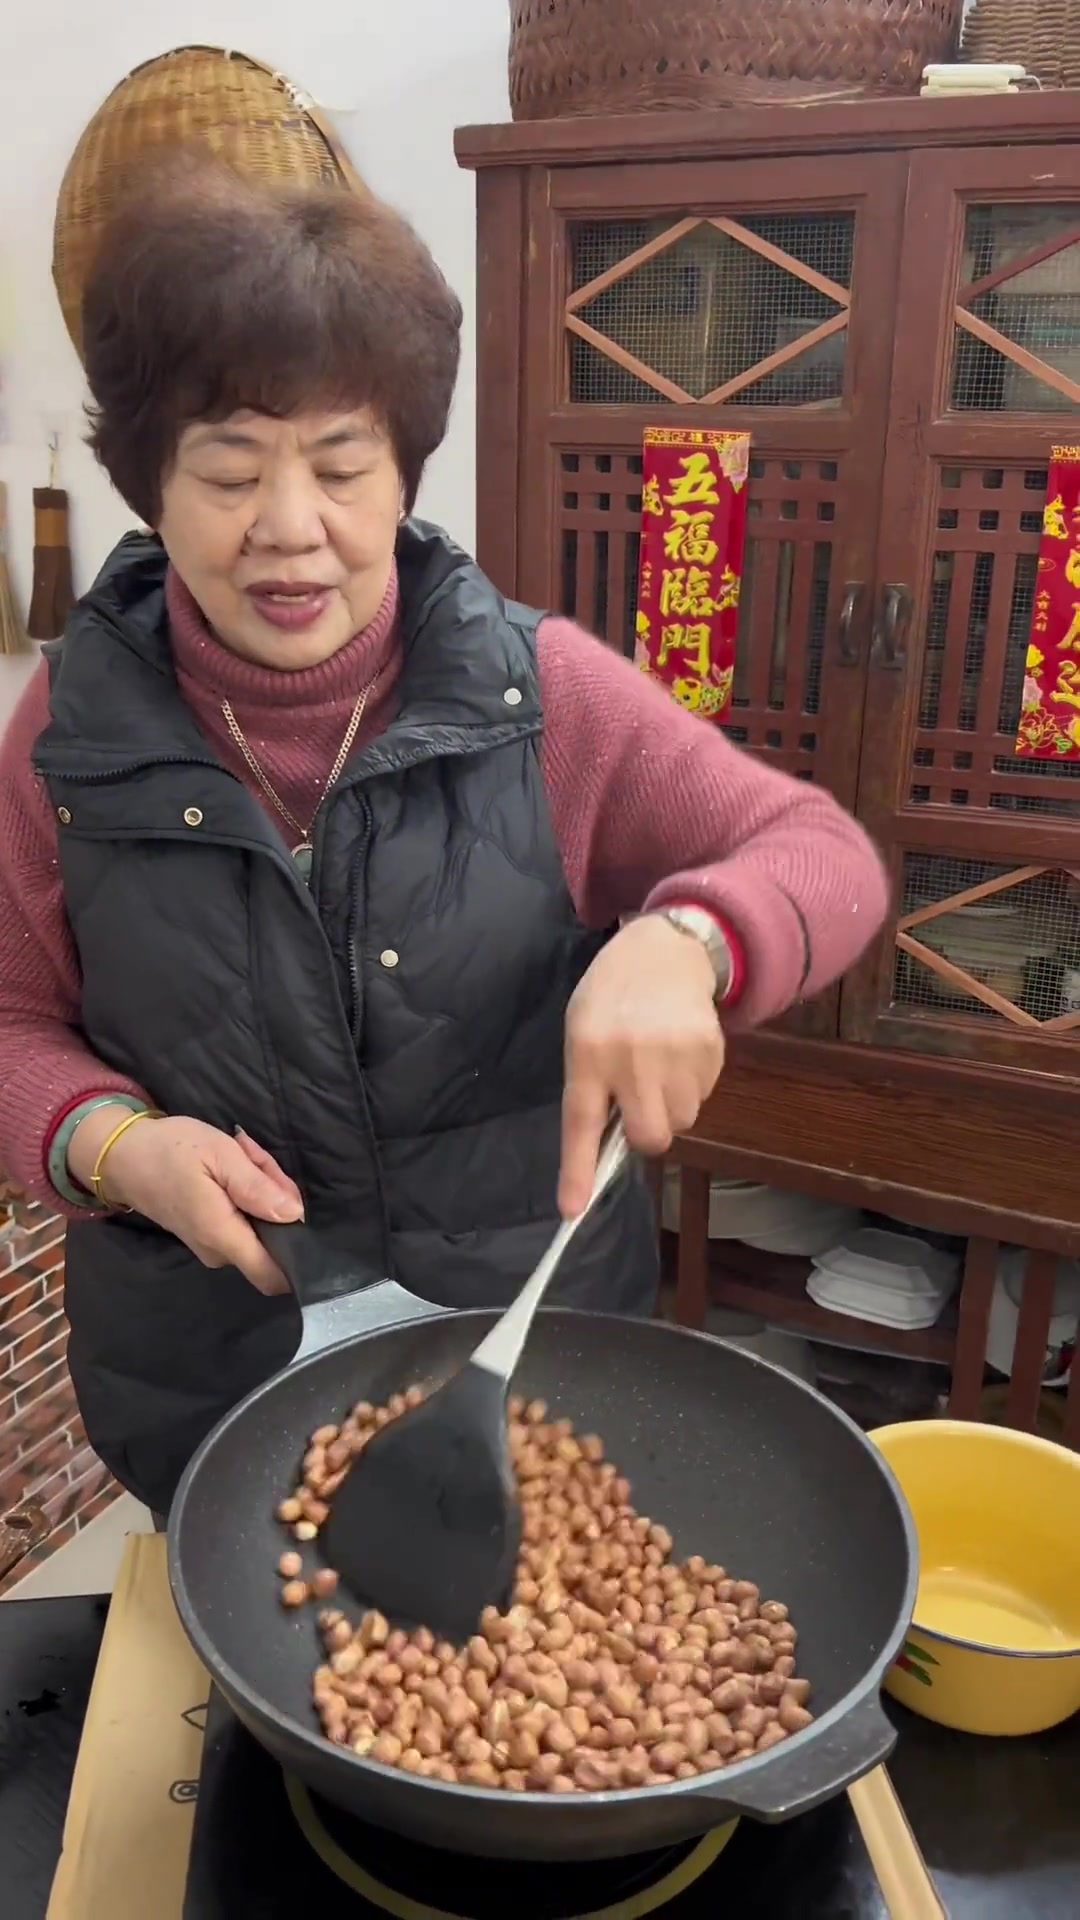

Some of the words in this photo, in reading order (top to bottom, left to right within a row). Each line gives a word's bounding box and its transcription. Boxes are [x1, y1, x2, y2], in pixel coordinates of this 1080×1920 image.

[657, 452, 720, 678] 五福臨門
[1035, 590, 1051, 632] 大吉大利
